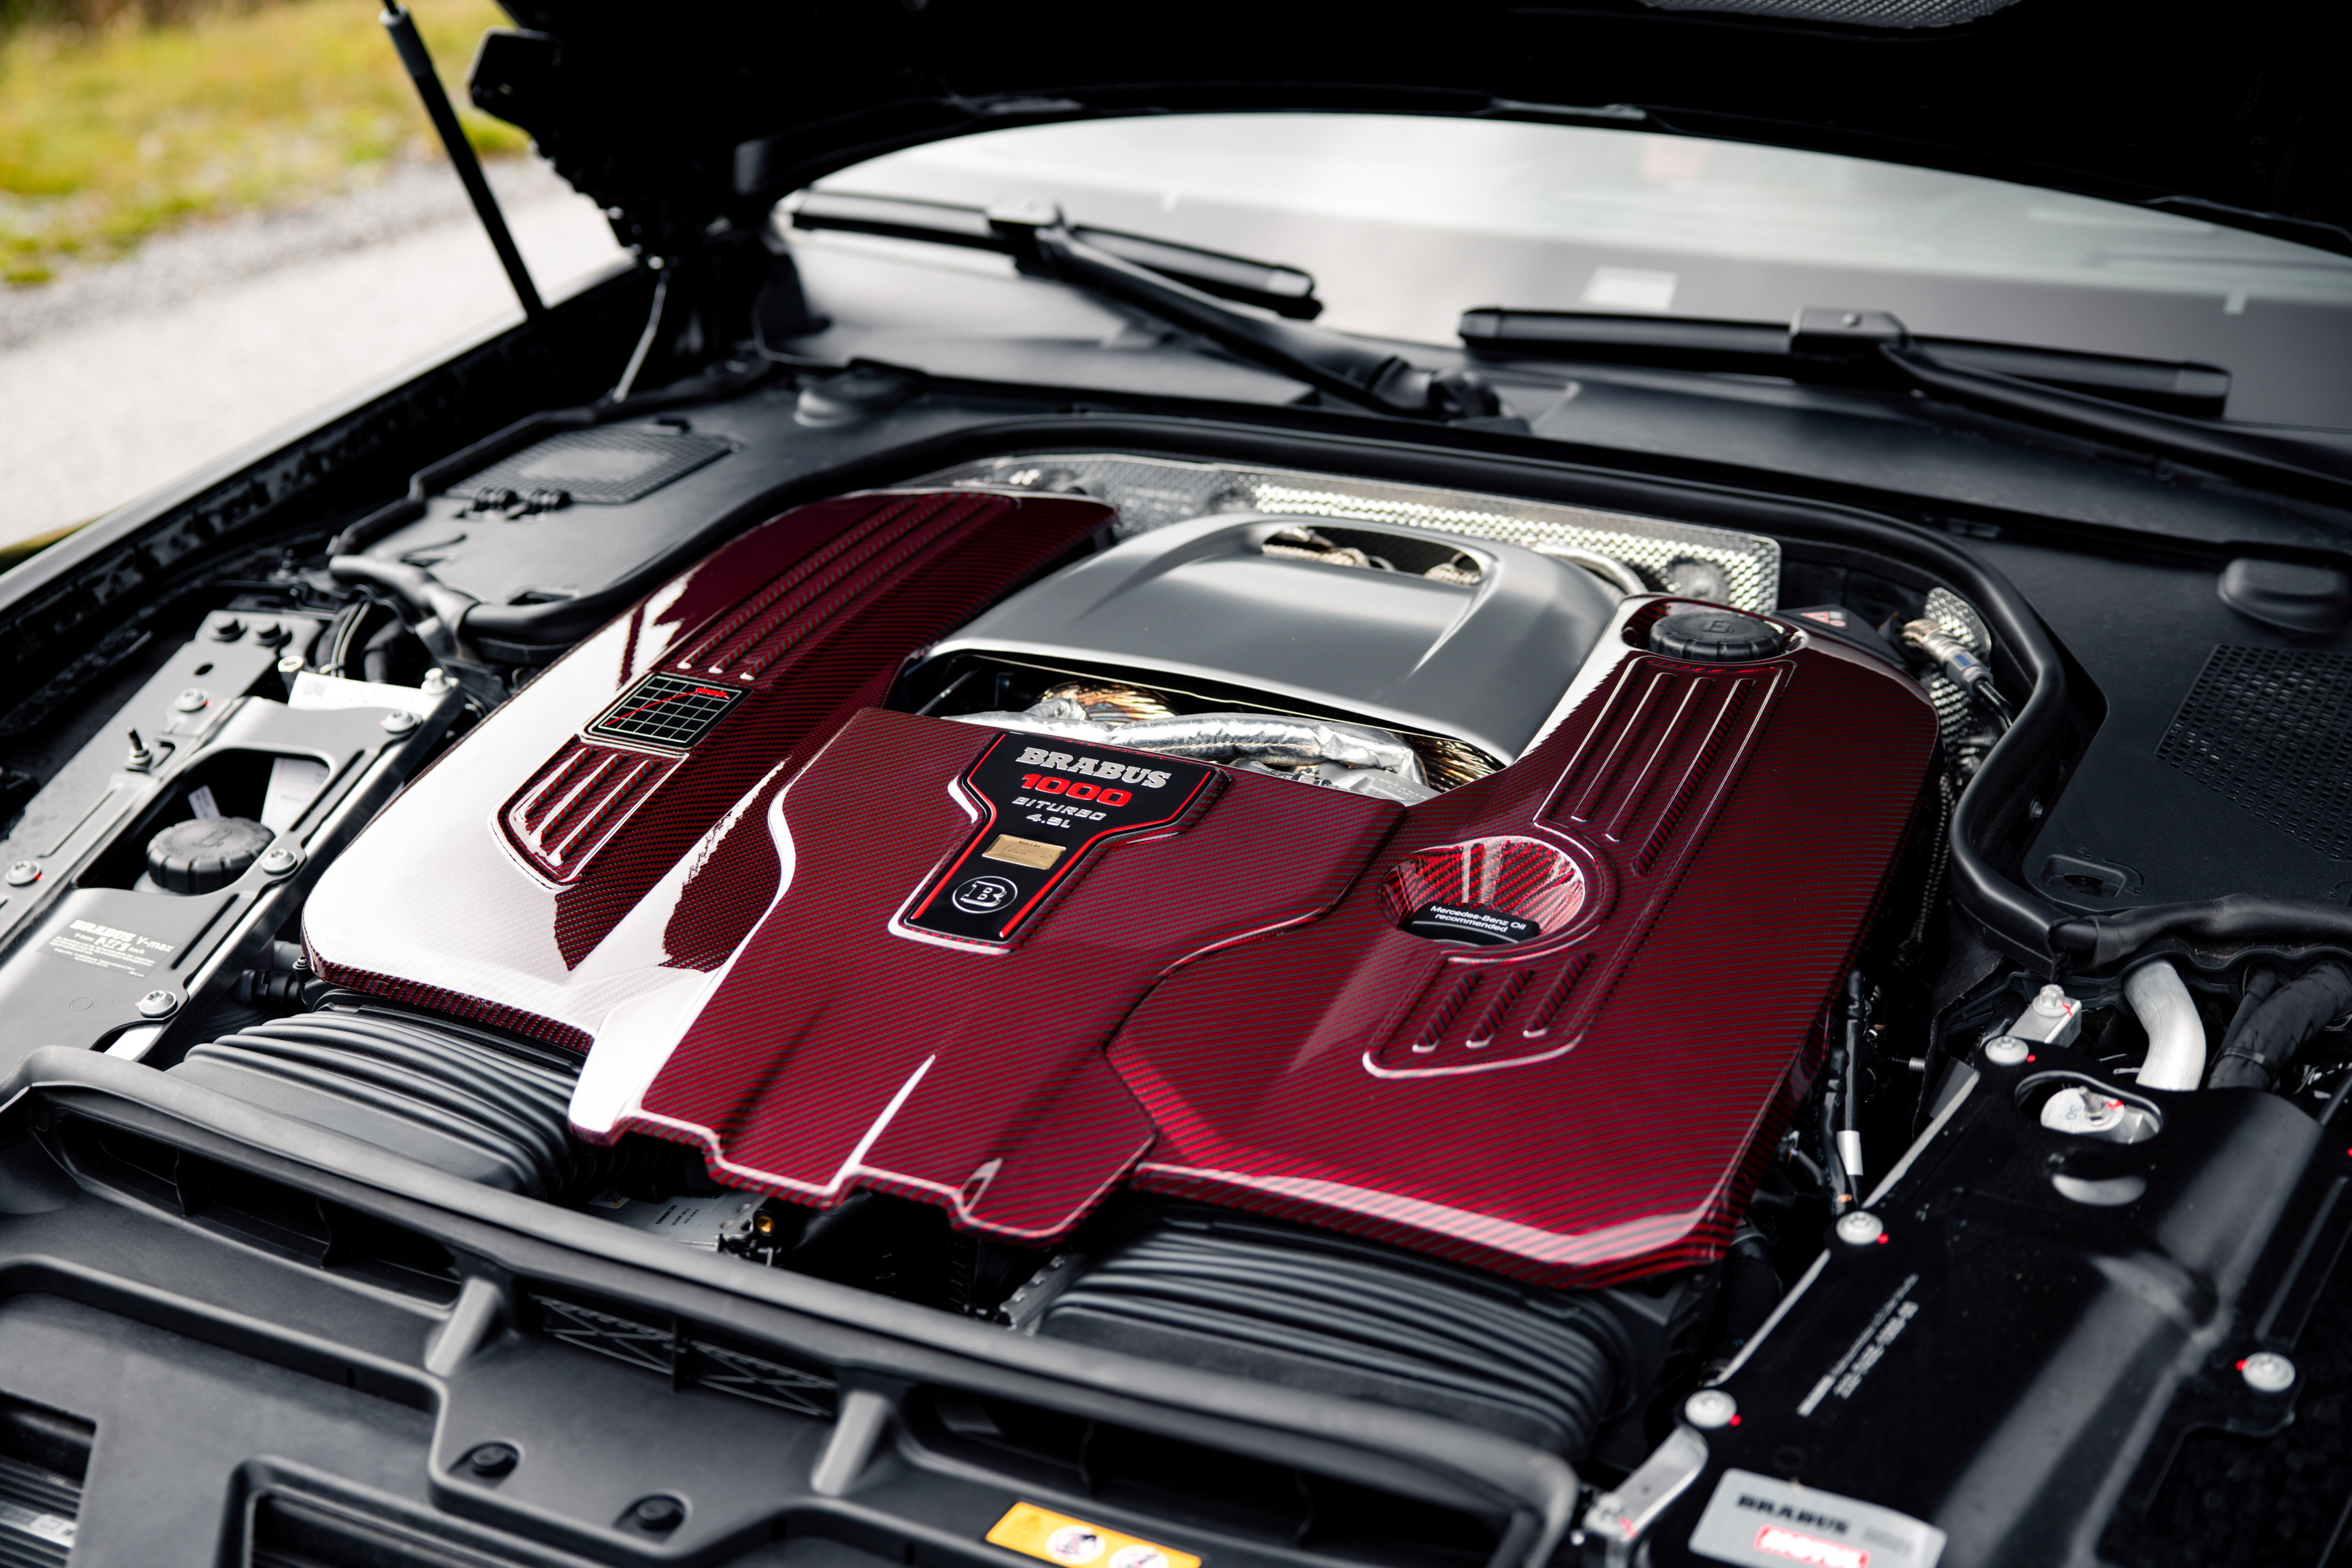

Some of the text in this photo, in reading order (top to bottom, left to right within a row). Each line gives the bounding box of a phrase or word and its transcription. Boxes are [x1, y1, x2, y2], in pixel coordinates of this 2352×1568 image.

[1016, 747, 1172, 788] BRABUS
[1021, 774, 1133, 807] 1000
[1012, 797, 1106, 821] BITURBO
[1026, 814, 1072, 828] 4.5L
[1430, 906, 1526, 930] Mercedes-Benz Oil
[1435, 913, 1508, 932] recommended
[69, 919, 137, 942] BRABUS
[136, 936, 175, 953] V-max
[1737, 1494, 1849, 1534] BRABUS
